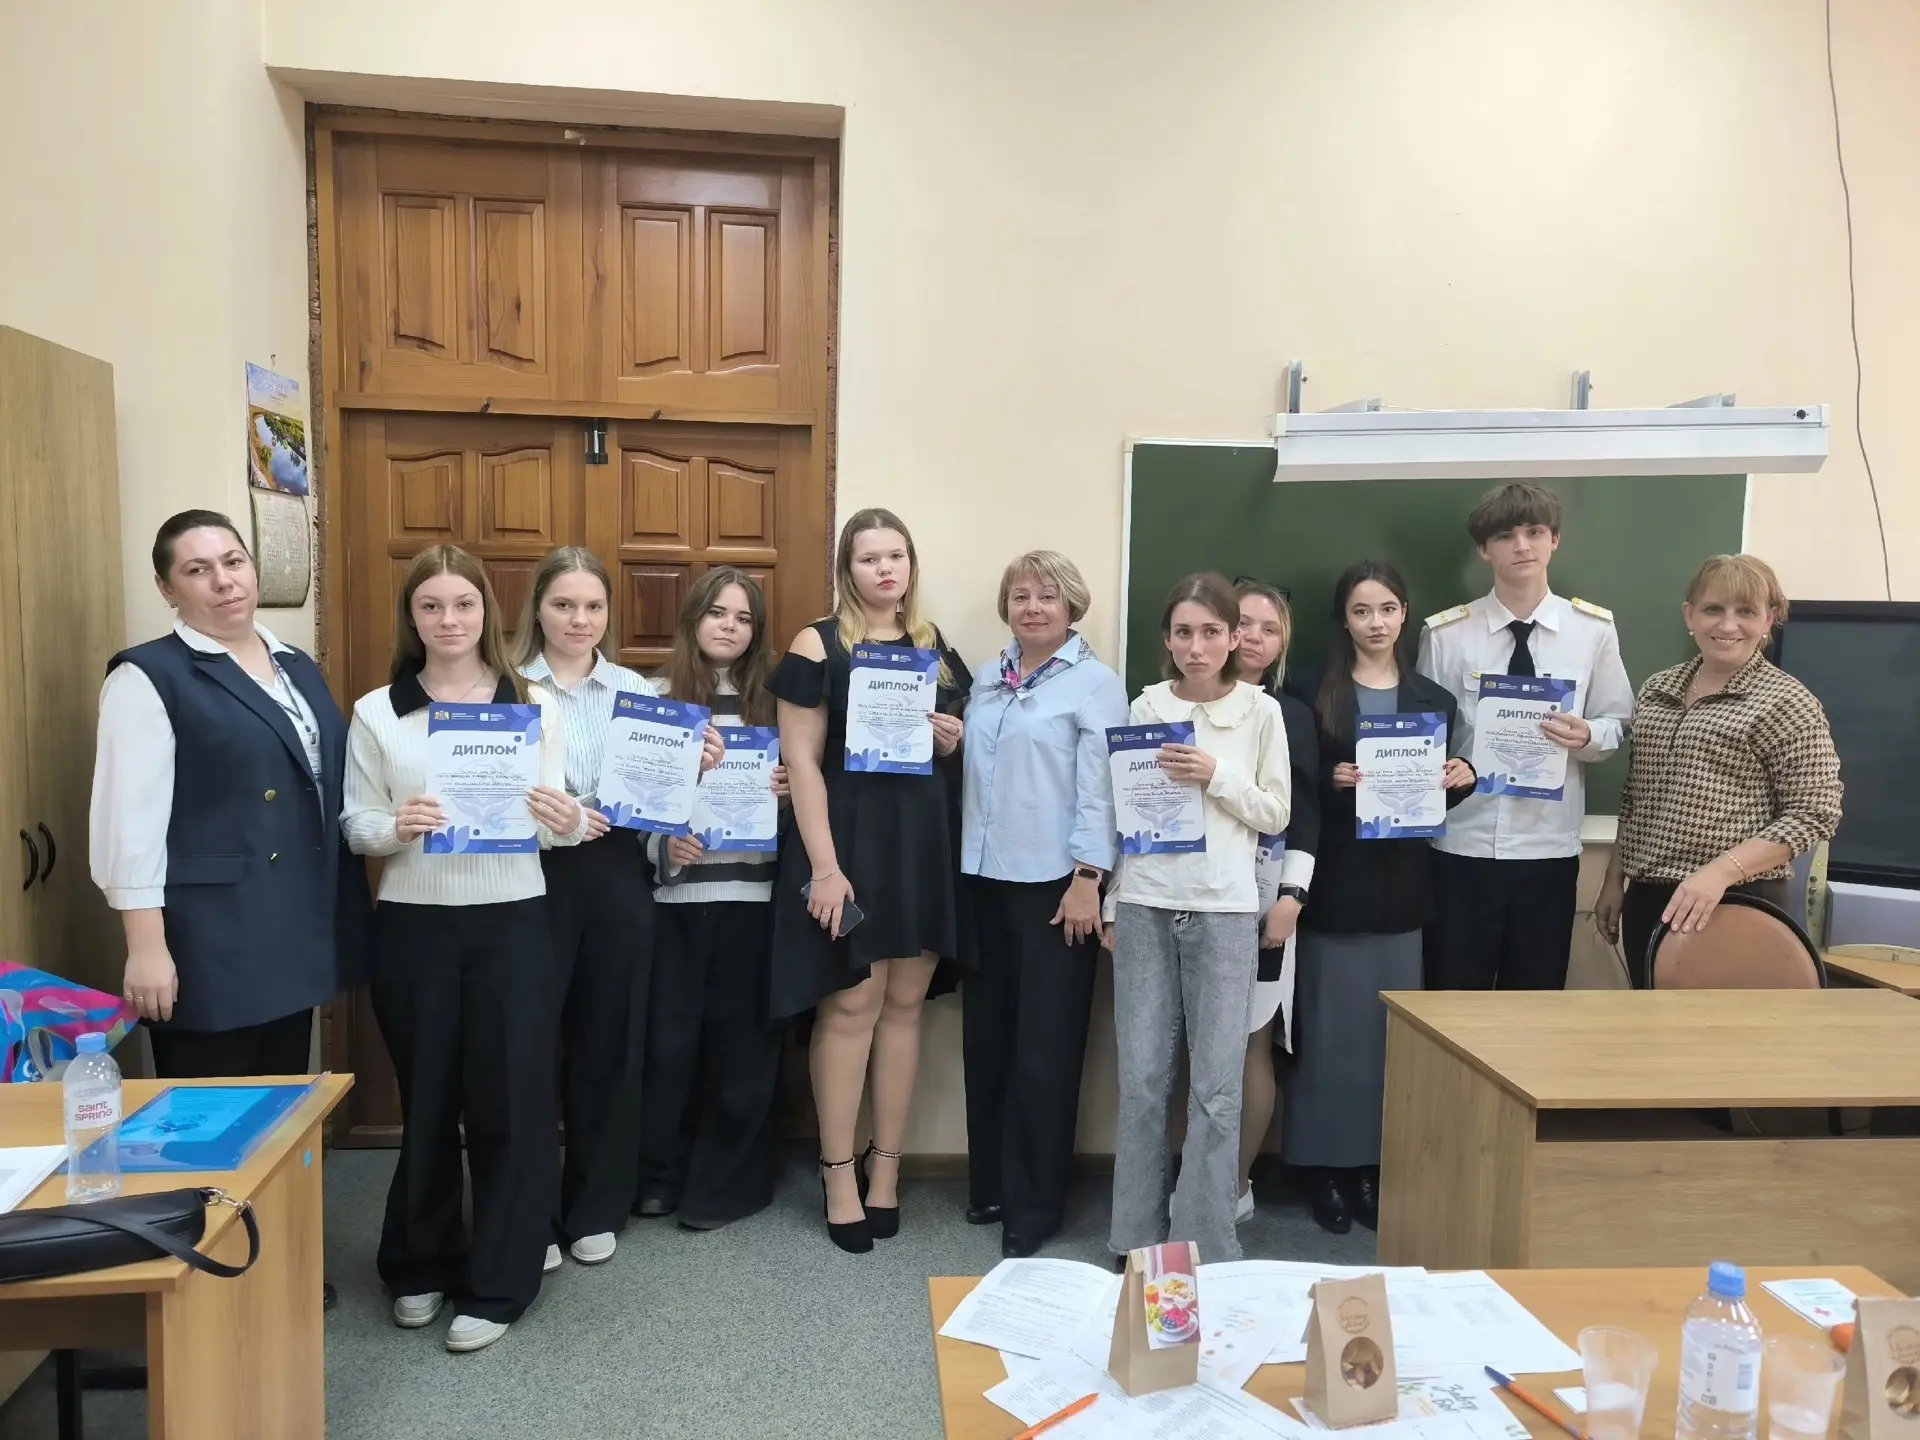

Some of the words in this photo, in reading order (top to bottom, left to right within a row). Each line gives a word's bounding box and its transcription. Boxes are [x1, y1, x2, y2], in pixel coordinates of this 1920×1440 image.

[869, 680, 919, 693] ДИПЛОМ
[1497, 709, 1552, 721] ДИПЛОМ
[628, 731, 684, 749] ДИПЛОМ
[452, 745, 517, 756] ДИПЛОМ
[1375, 748, 1428, 759] ДИПЛОМ
[717, 761, 761, 770] ИПЛОМ
[1129, 760, 1162, 772] ДИПЛ
